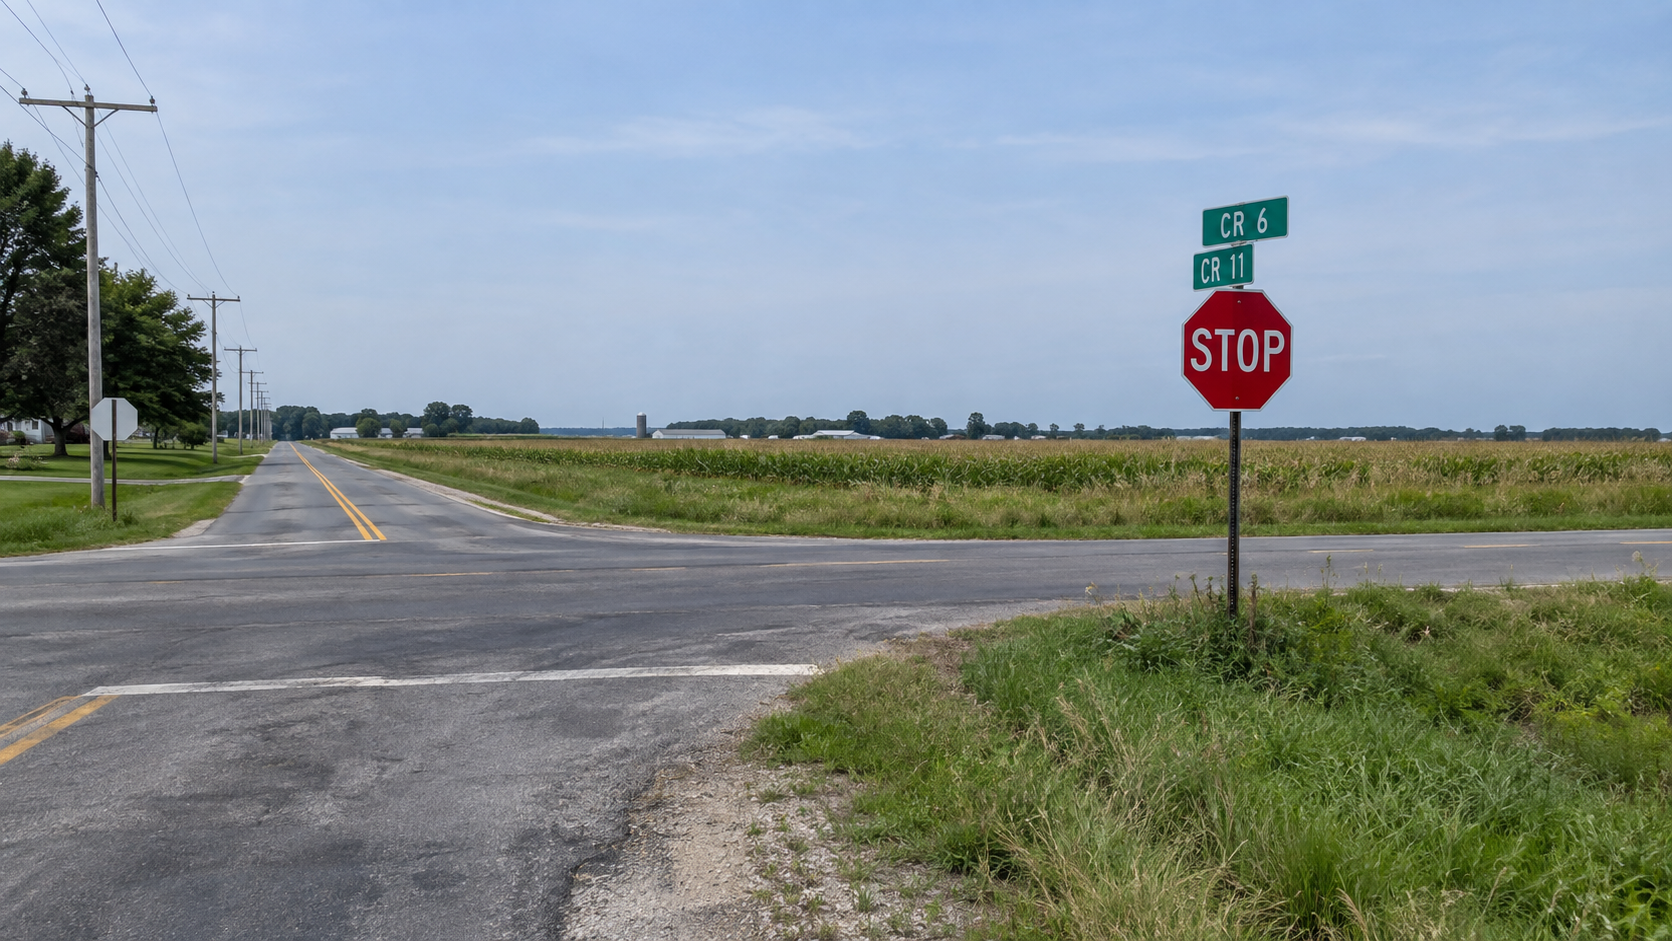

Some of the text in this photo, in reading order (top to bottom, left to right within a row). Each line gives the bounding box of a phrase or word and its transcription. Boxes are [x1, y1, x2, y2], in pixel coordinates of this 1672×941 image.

[1220, 207, 1268, 239] CR 6
[1201, 252, 1244, 284] CR 11
[1190, 327, 1285, 373] STOP
